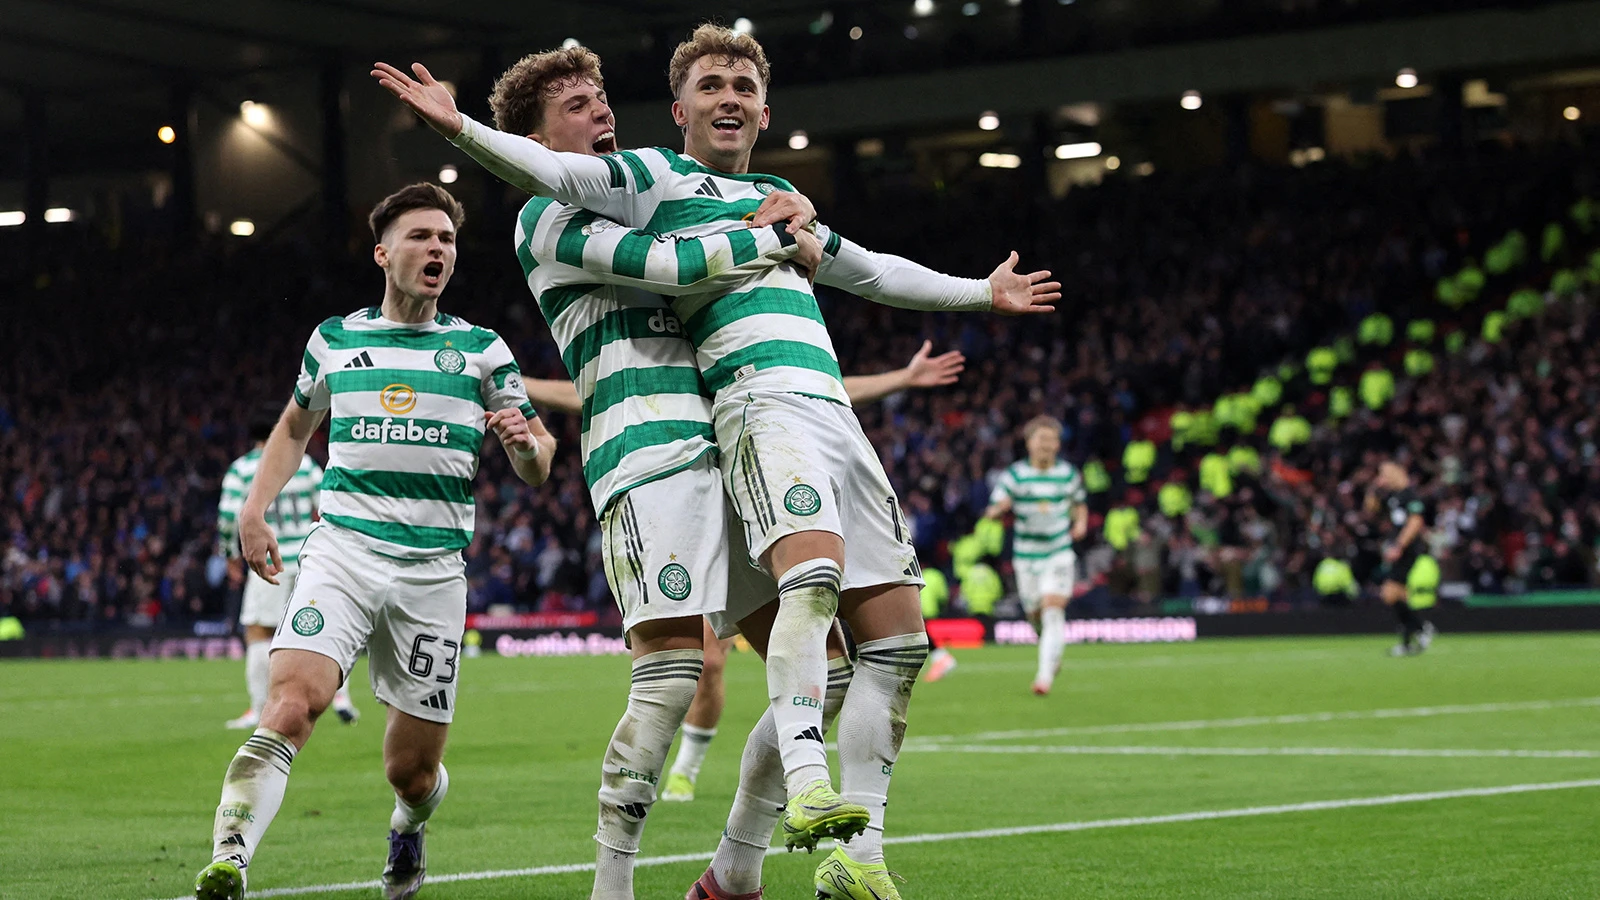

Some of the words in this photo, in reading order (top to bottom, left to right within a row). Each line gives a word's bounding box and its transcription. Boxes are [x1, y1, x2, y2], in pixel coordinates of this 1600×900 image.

[350, 417, 450, 445] dafabet
[408, 634, 458, 684] 63
[620, 767, 658, 786] CELTIC
[222, 808, 255, 823] CELTIC
